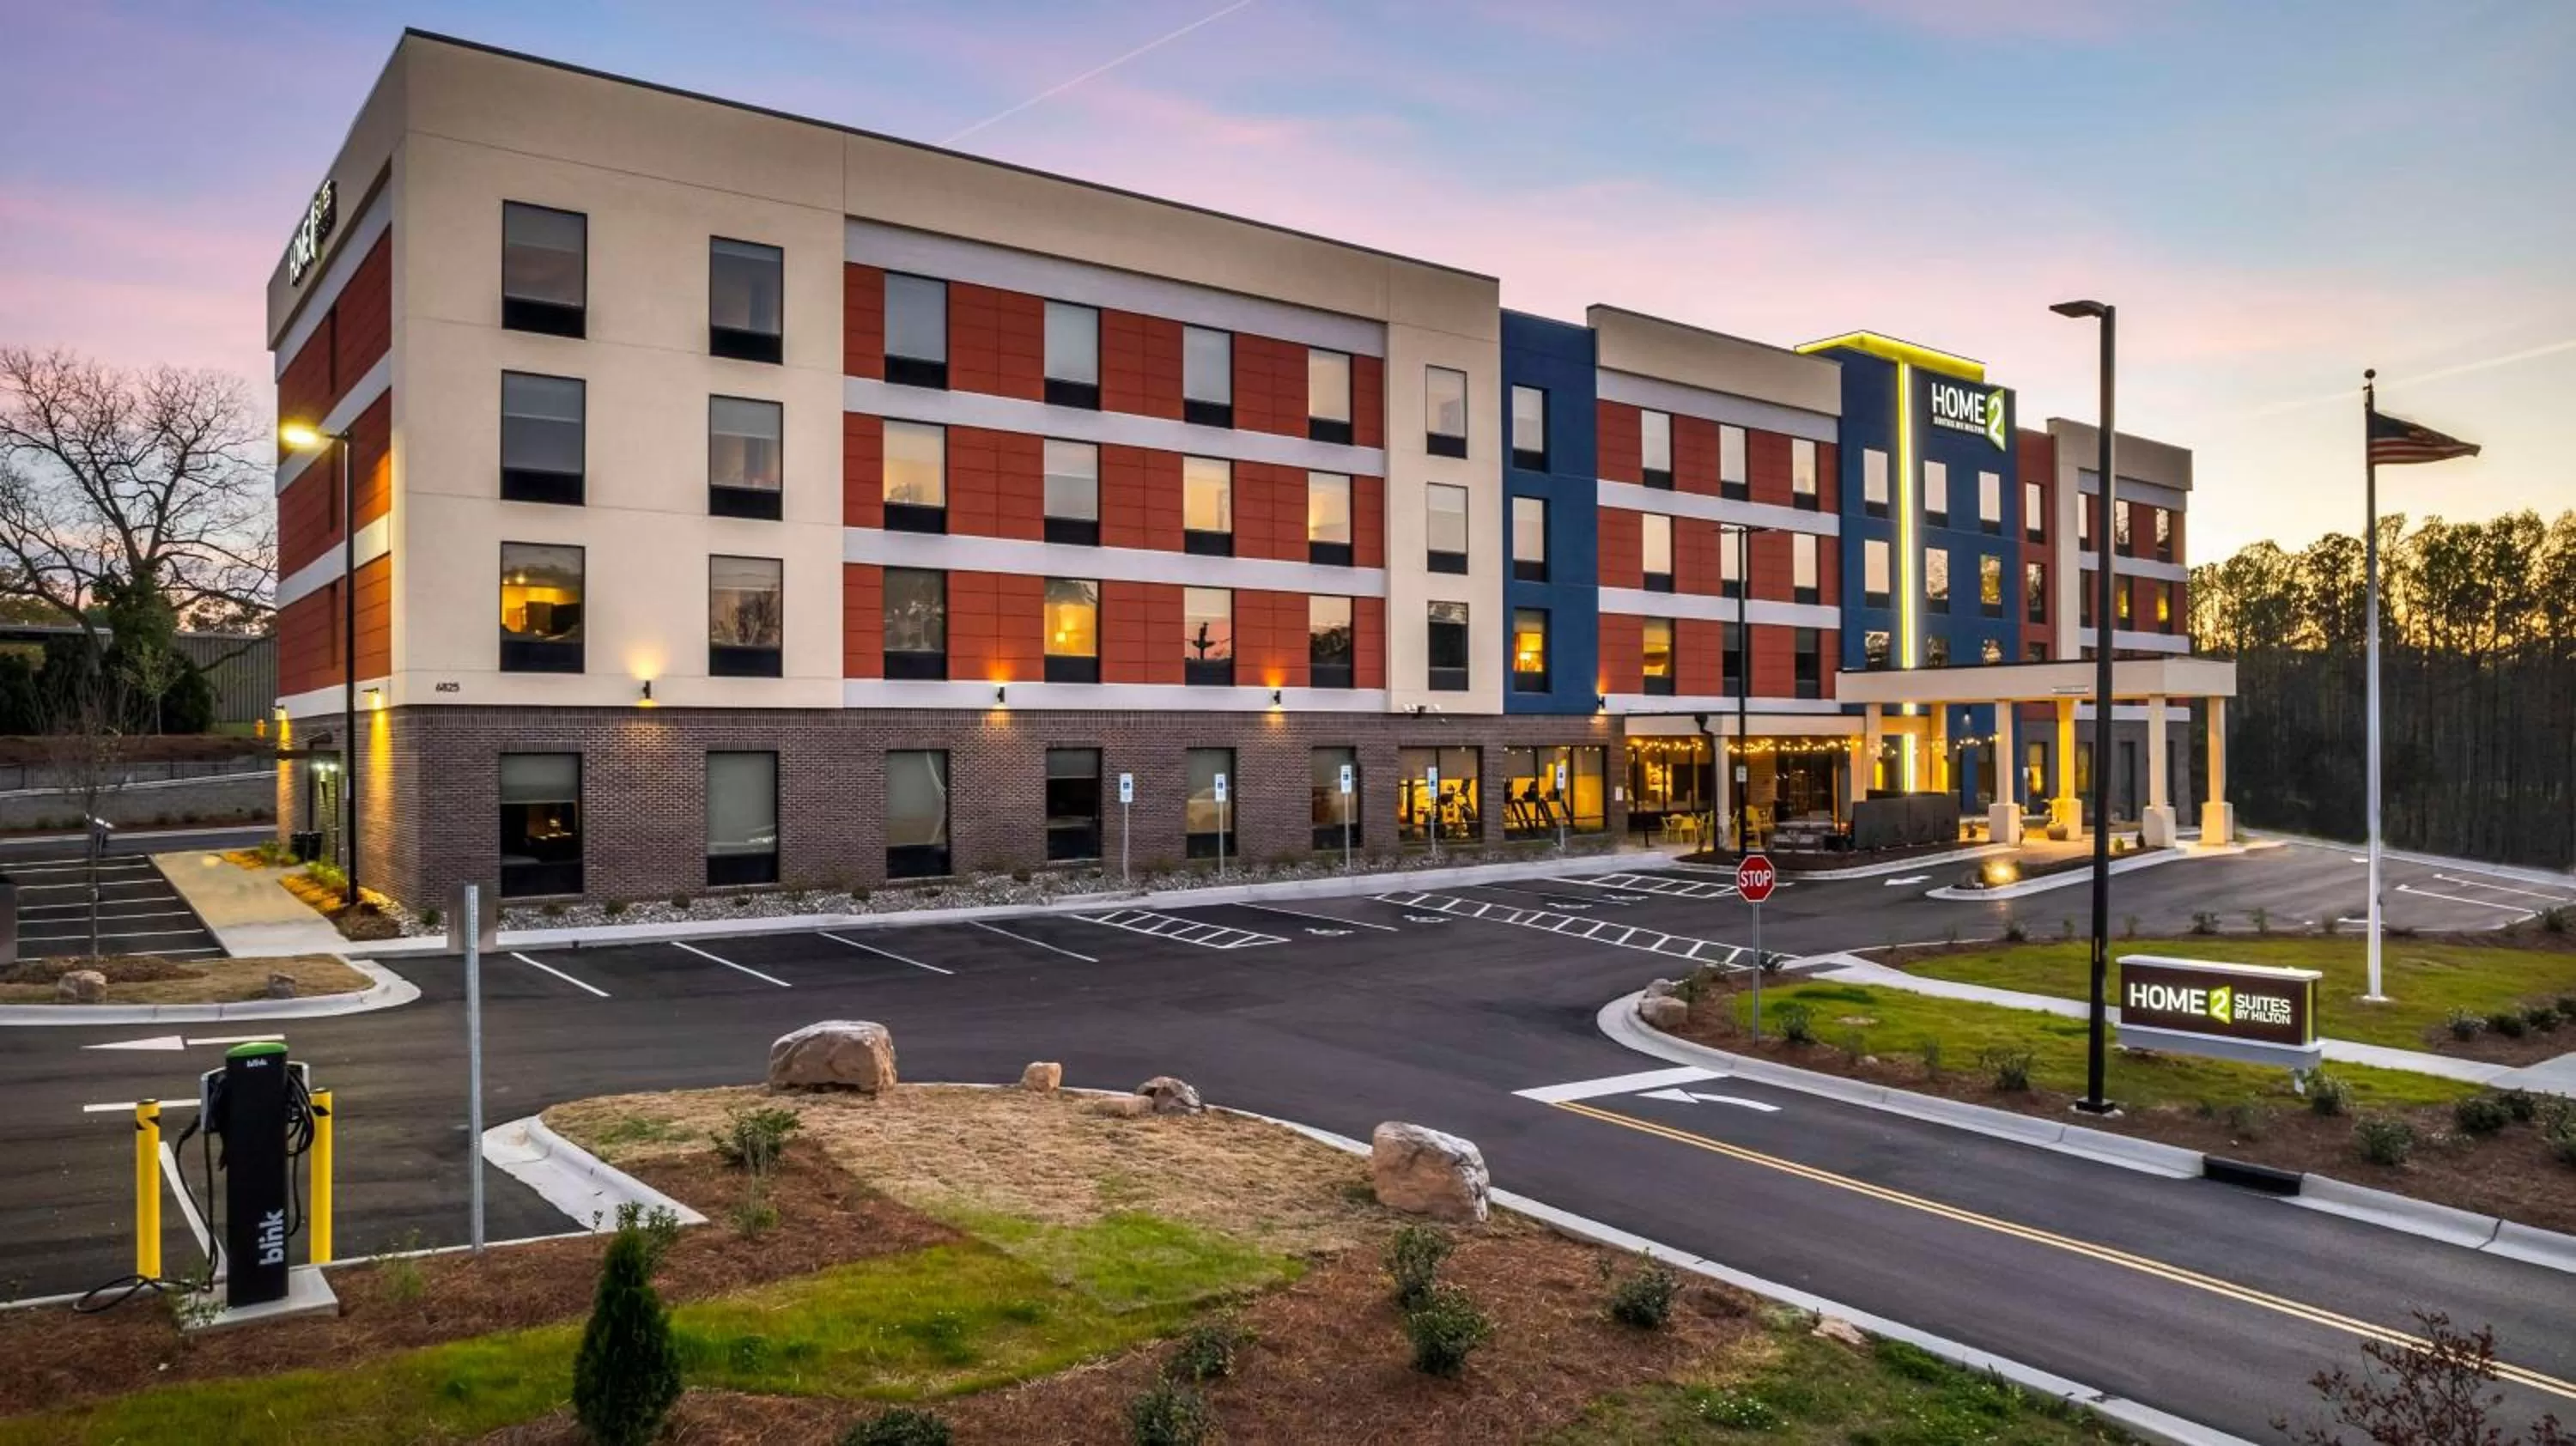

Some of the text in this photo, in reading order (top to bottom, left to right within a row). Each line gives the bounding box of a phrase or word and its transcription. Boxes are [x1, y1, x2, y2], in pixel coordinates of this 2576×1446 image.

[1741, 870, 1771, 887] STOP
[2234, 993, 2291, 1013] SUITES
[2235, 1008, 2291, 1024] BY HILTON
[258, 1208, 284, 1266] blink
